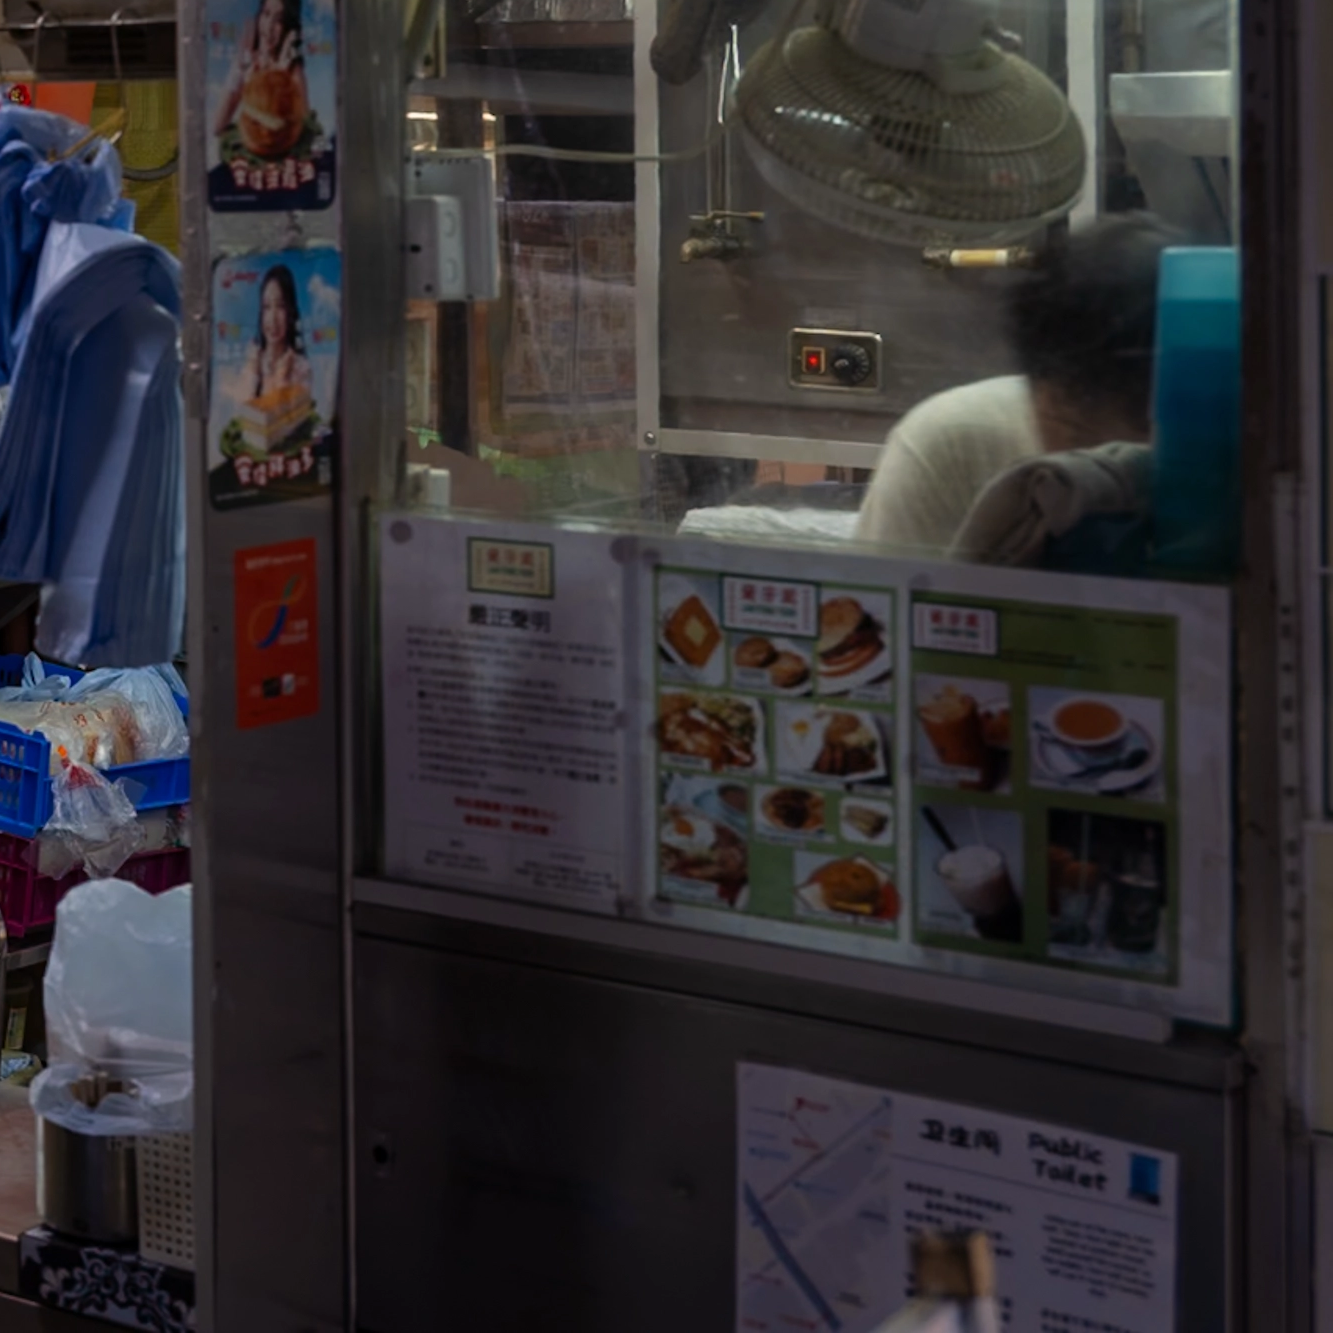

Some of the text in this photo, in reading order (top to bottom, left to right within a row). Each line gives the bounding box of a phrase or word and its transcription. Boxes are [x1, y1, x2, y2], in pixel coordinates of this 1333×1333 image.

[468, 604, 551, 634] 嚴正聲明
[919, 1118, 1002, 1156] 卫生间
[1028, 1132, 1103, 1166] Public
[1032, 1159, 1108, 1191] Toilet
